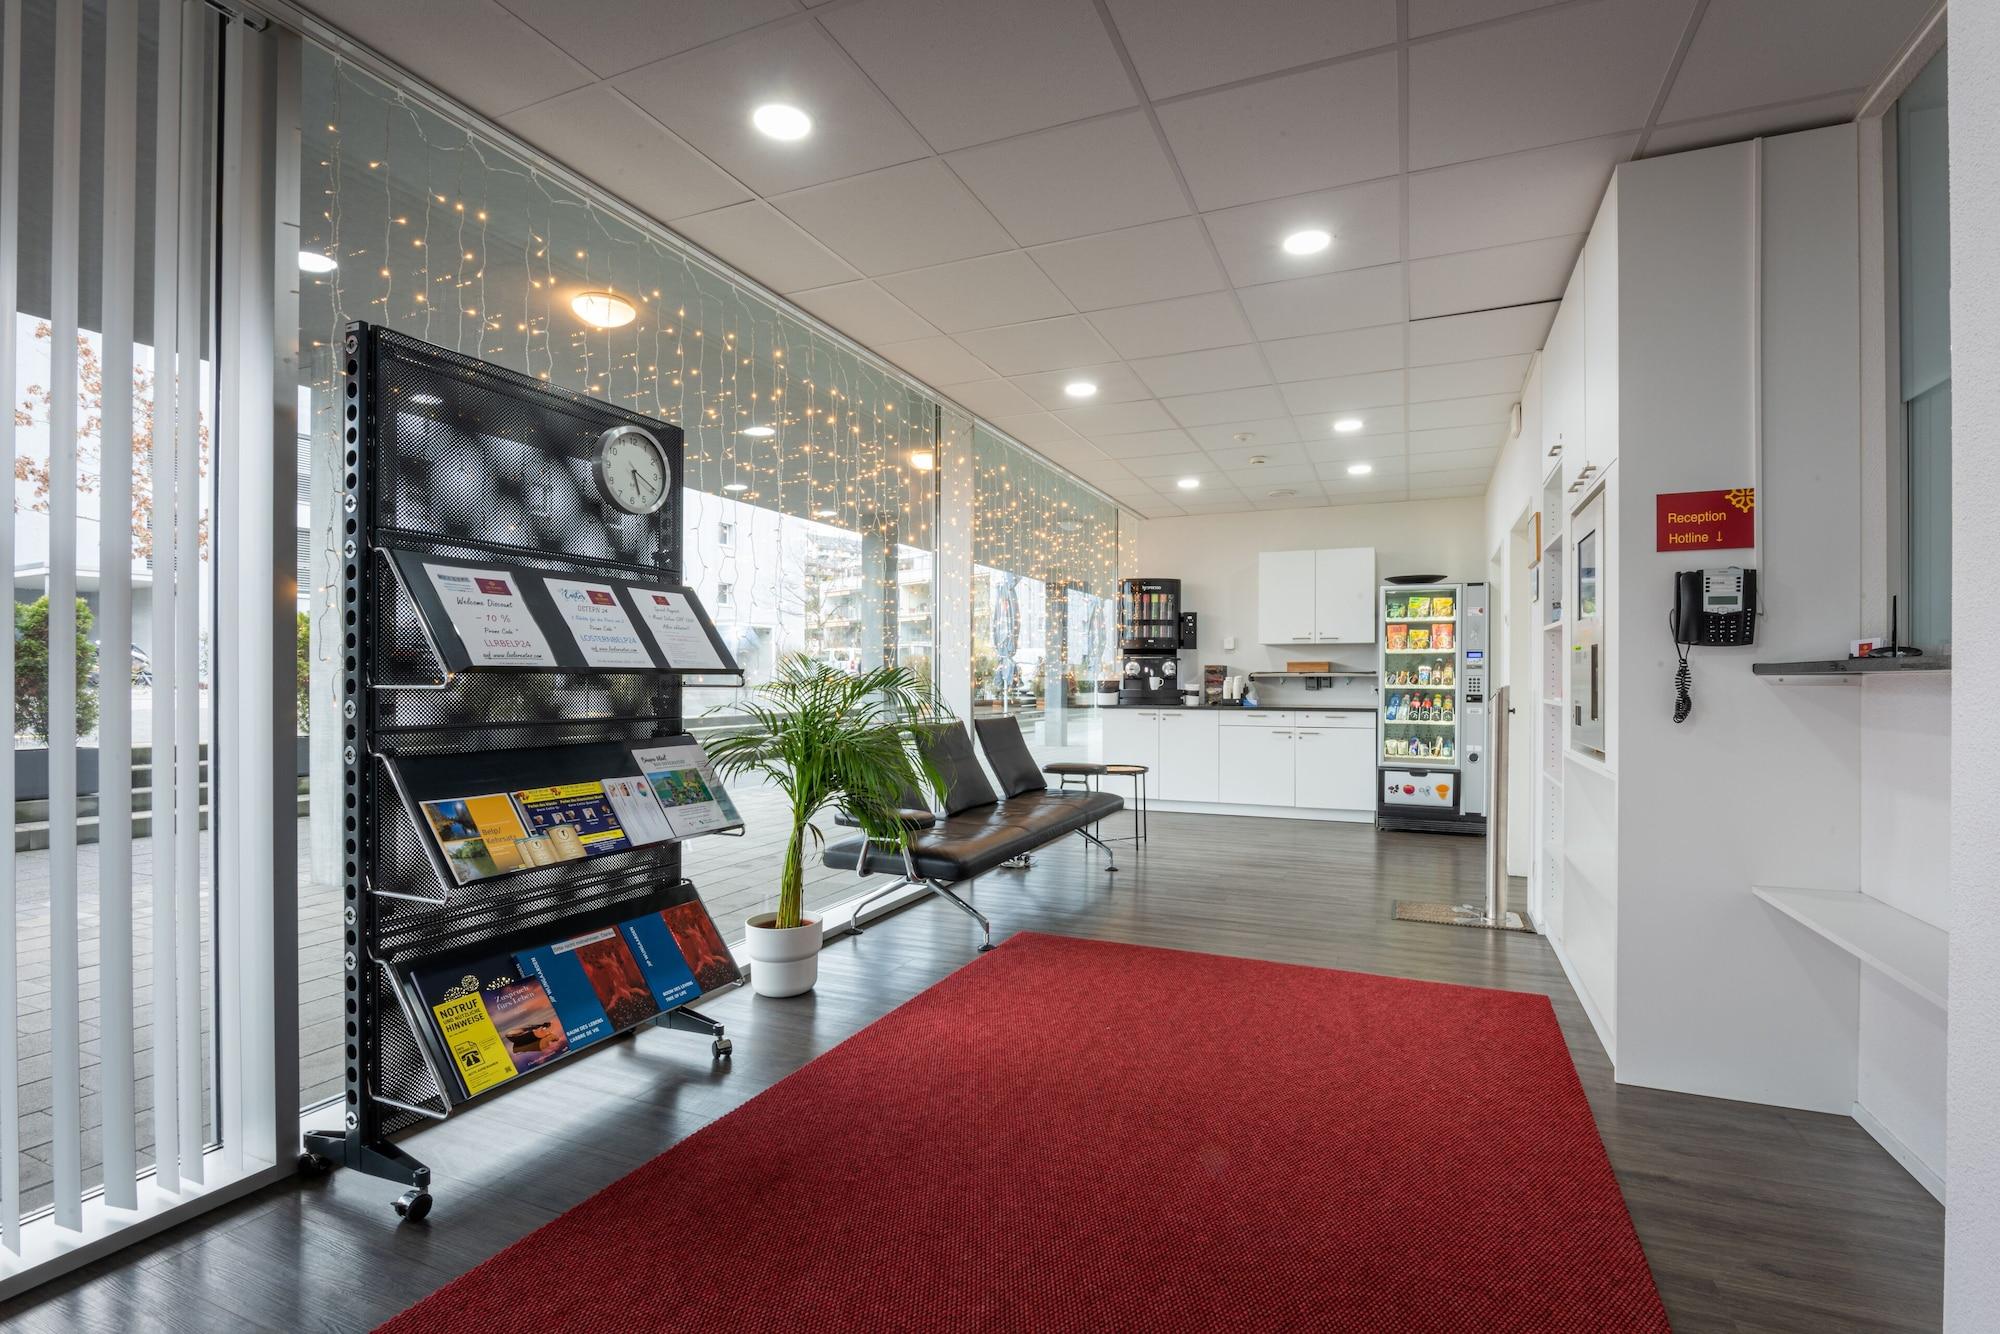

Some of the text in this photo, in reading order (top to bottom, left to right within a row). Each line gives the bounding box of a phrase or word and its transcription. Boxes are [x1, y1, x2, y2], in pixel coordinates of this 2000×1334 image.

[618, 438, 626, 447] 11
[630, 437, 638, 446] 12
[609, 447, 618, 456] 10
[650, 458, 655, 467] 2
[653, 473, 658, 481] 3
[618, 489, 623, 497] 7
[629, 496, 635, 505] 6
[641, 495, 647, 503] 5
[1667, 511, 1727, 524] Reception
[1668, 532, 1709, 544] Hotline
[456, 597, 513, 608] Welcome Discount
[486, 614, 497, 622] 10
[500, 614, 511, 623] %
[495, 986, 529, 1003] Zuspruch
[512, 992, 535, 1004] Leben
[439, 998, 478, 1019] NOTRUF
[445, 1013, 485, 1033] HINWEISE
